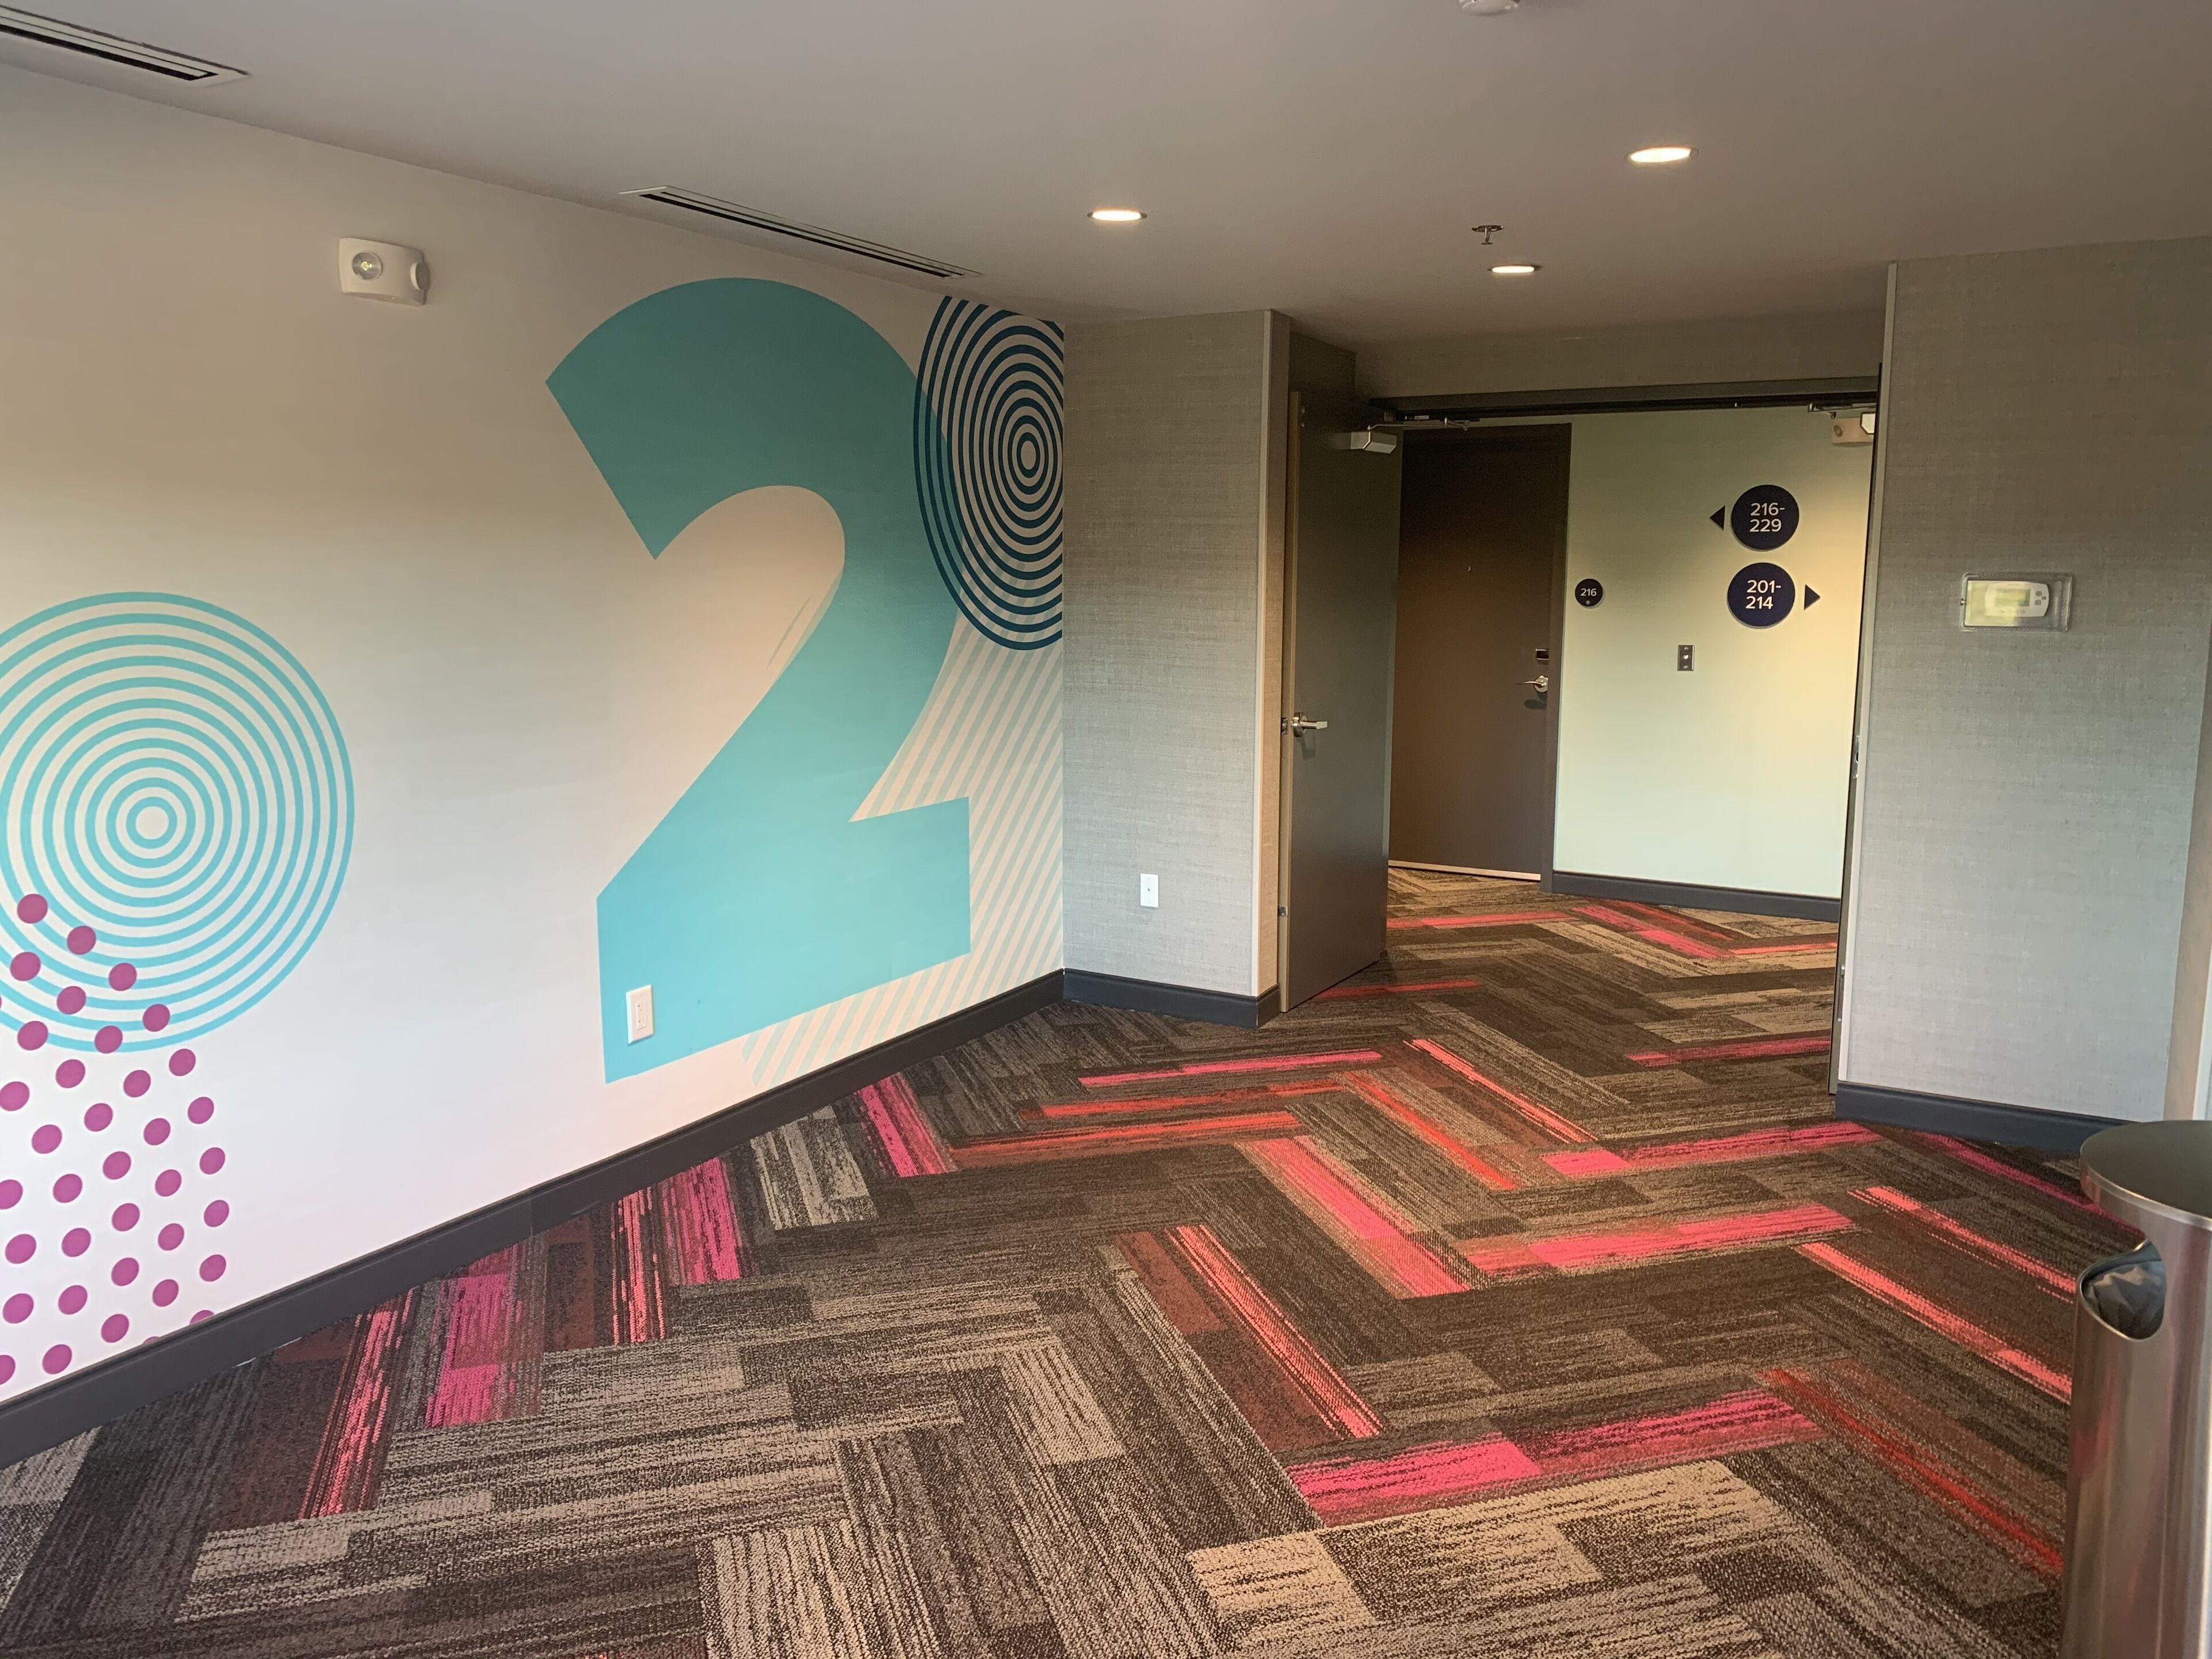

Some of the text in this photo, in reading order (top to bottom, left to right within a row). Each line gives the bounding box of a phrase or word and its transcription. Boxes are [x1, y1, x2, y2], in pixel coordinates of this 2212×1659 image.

[1750, 502, 1785, 516] 216-
[1749, 518, 1782, 532] 229
[1581, 588, 1597, 596] 216
[1747, 579, 1781, 593] 201-
[1745, 596, 1774, 609] 214
[545, 278, 971, 1084] 2
